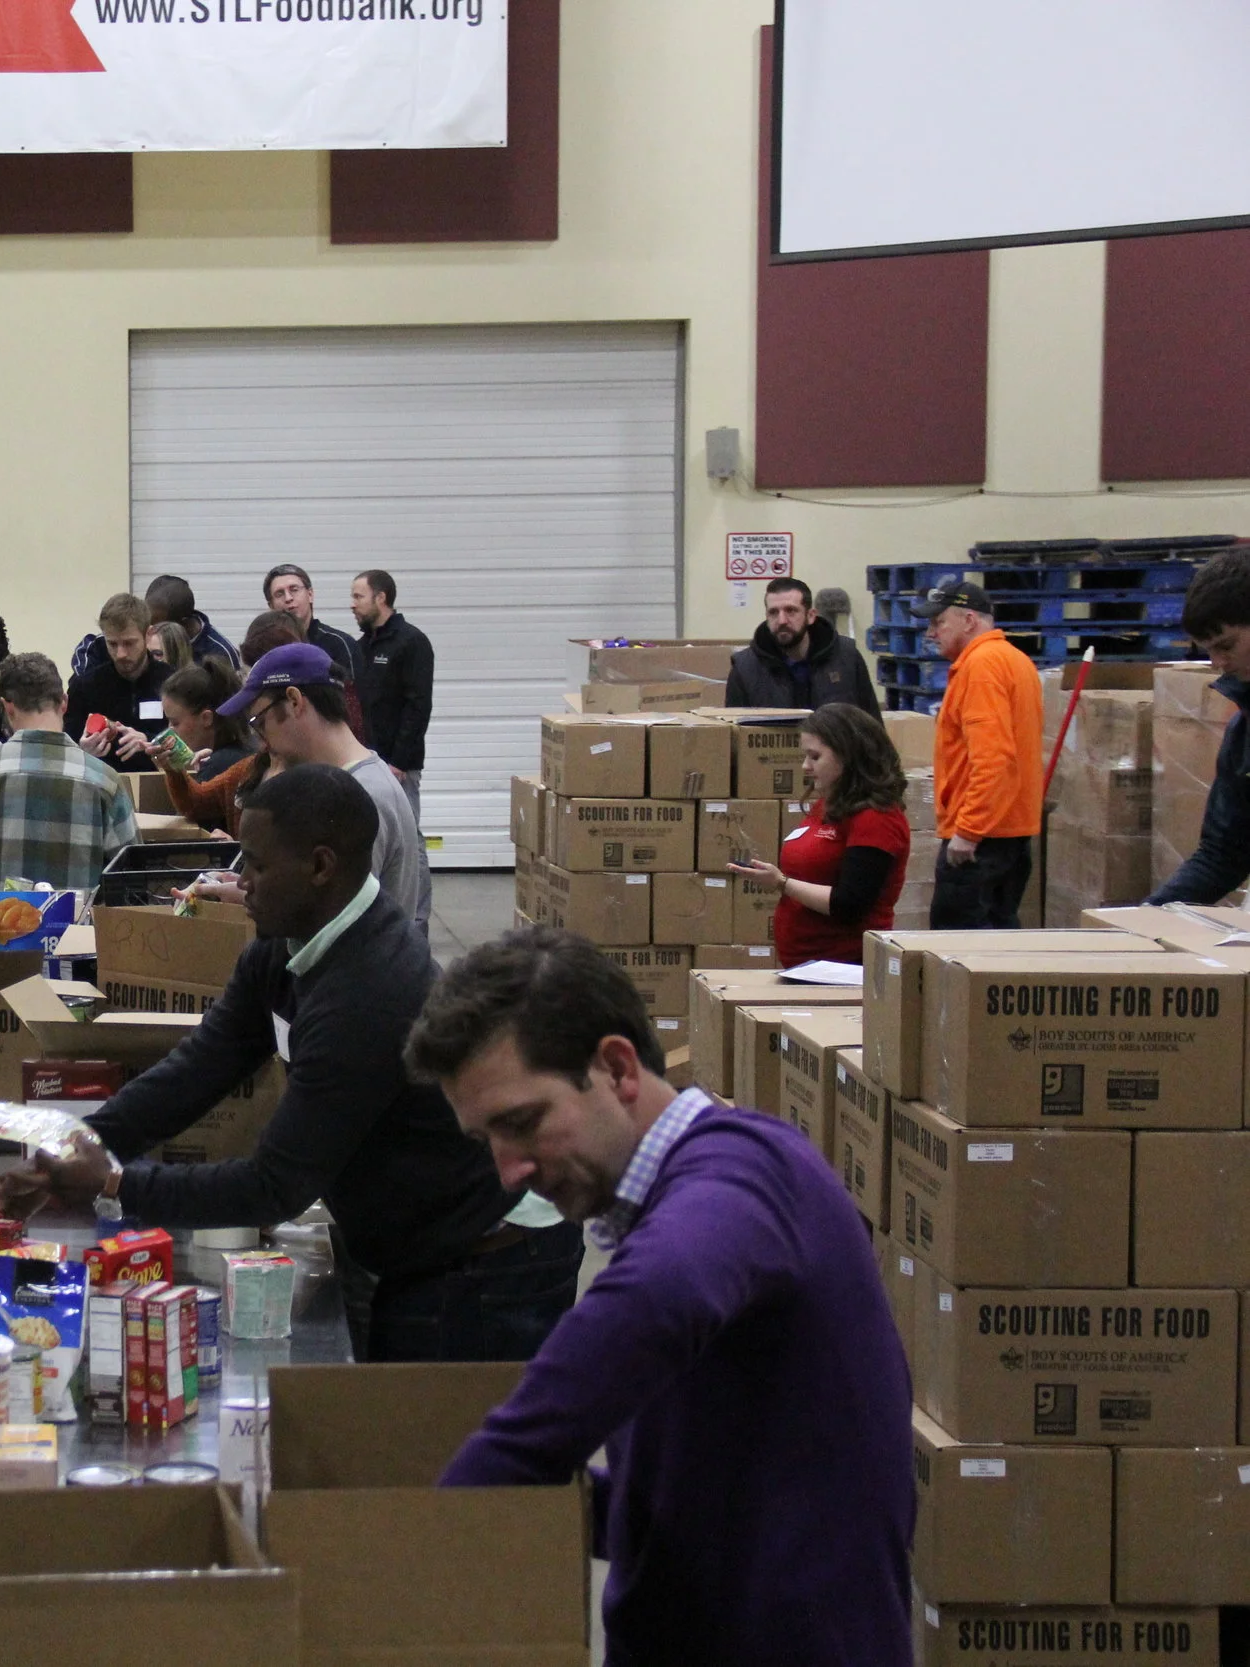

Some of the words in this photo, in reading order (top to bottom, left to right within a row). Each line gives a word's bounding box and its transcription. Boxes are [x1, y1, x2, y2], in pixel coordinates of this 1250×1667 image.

[747, 733, 799, 748] SCOUTING
[578, 806, 629, 821] SCOUTING
[633, 807, 653, 821] FOR
[657, 807, 683, 821] FOOD
[632, 951, 650, 965] FOR
[655, 951, 680, 965] FOOD
[105, 981, 166, 1013] SCOUTING
[172, 991, 195, 1014] FOR
[986, 985, 1099, 1017] SCOUTING
[1110, 986, 1152, 1017] FOR
[1162, 986, 1220, 1018] FOOD
[1038, 1030, 1064, 1041] BOY
[1067, 1031, 1115, 1042] SCOUTS
[1118, 1031, 1133, 1042] OF
[1137, 1031, 1195, 1043] AMERICA
[979, 1304, 1091, 1336] SCOUTING
[1101, 1307, 1142, 1337] FOR
[1153, 1308, 1211, 1338] FOOD
[1031, 1350, 1056, 1361] BOY
[1060, 1350, 1108, 1362] SCOUTS
[1110, 1351, 1126, 1362] OF
[1130, 1352, 1187, 1364] AMERICA
[958, 1621, 1071, 1652] SCOUTING
[1081, 1621, 1123, 1652] FOR
[1133, 1622, 1192, 1653] FOOD
